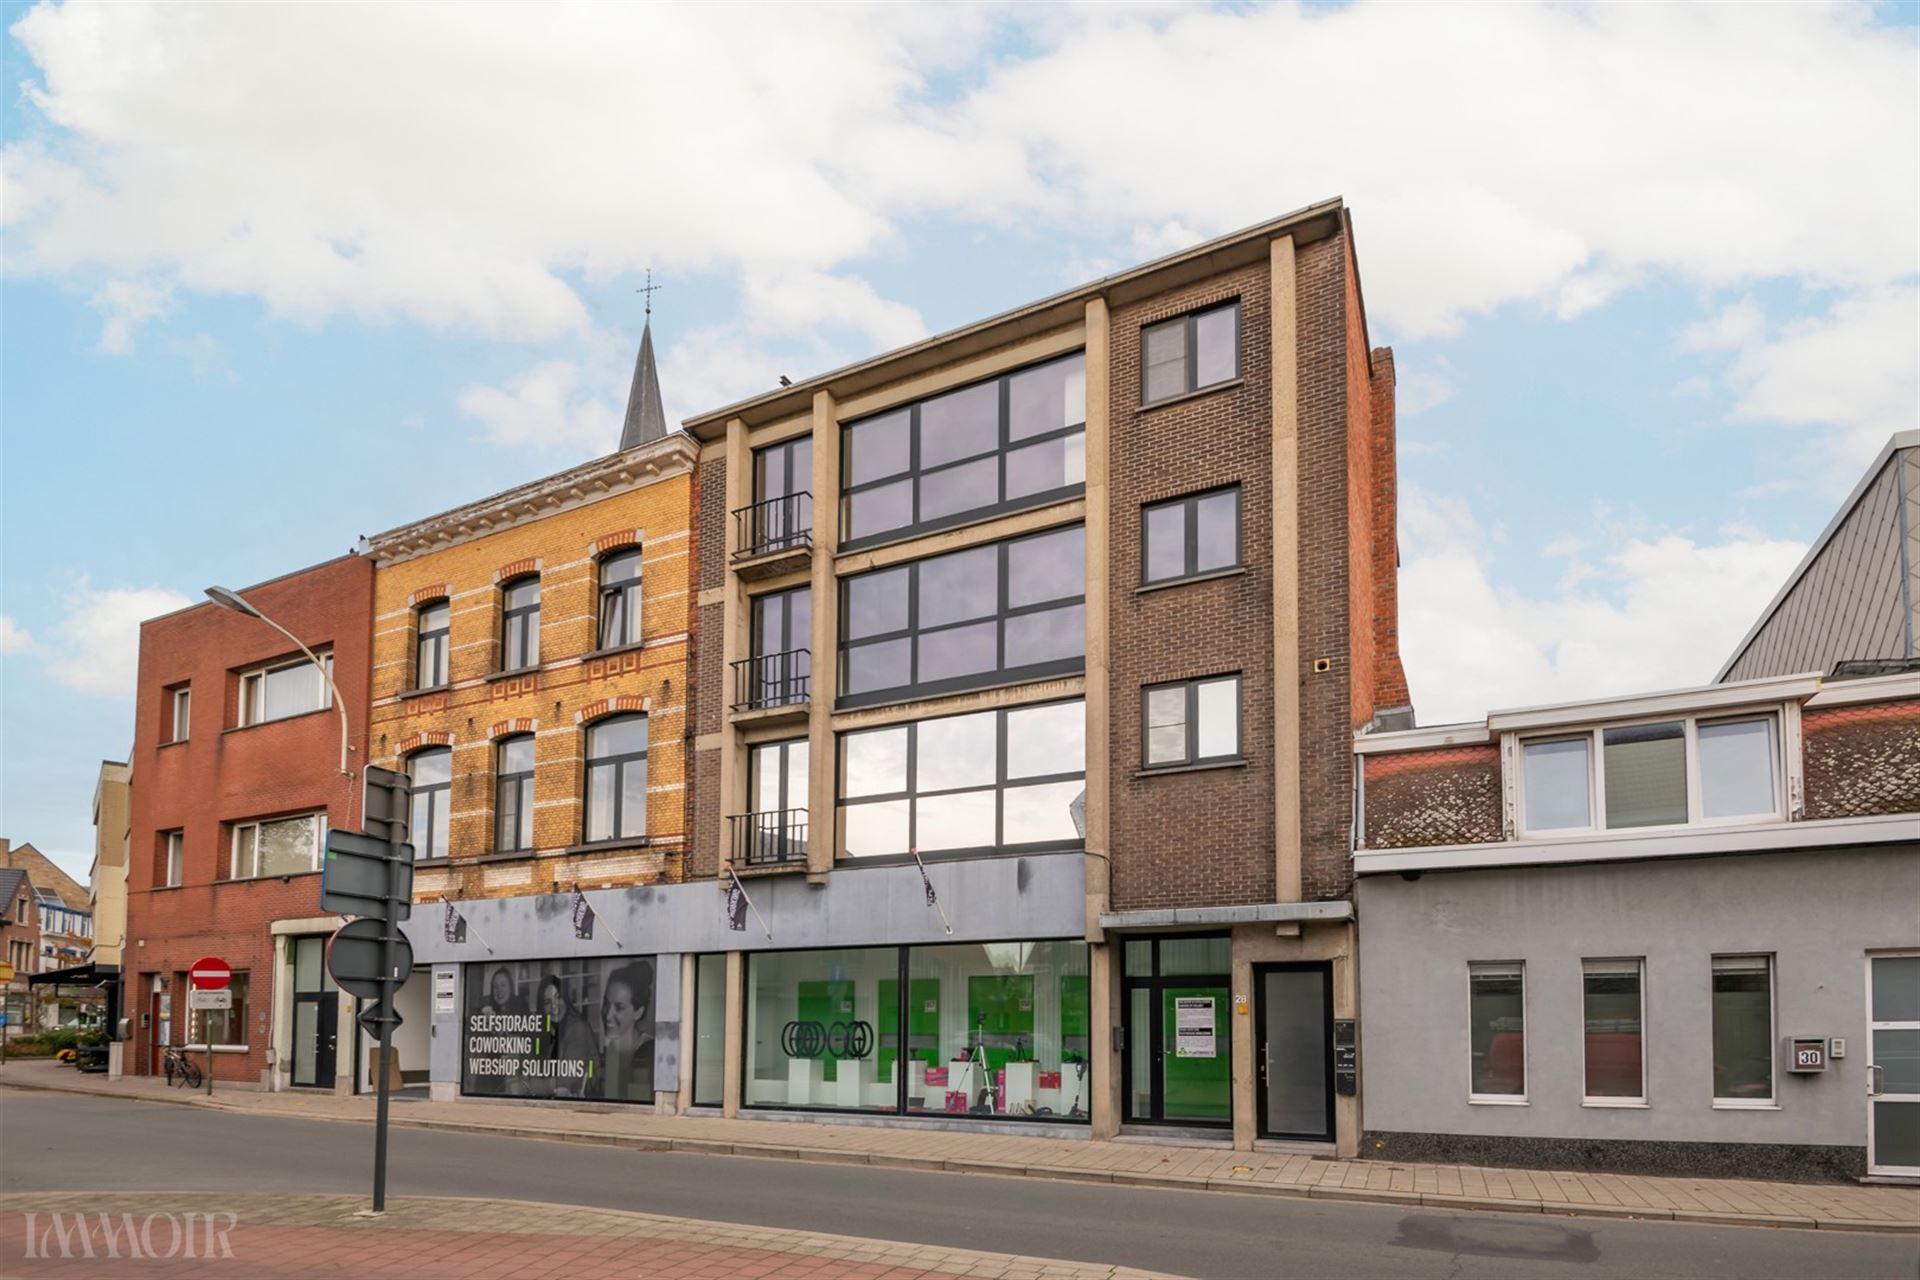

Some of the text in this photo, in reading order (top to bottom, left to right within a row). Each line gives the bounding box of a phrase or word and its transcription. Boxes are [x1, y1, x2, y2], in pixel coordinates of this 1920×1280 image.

[470, 1014, 543, 1032] SELFSTORAGE
[469, 1036, 532, 1054] COWORKING
[1801, 1051, 1818, 1064] 30
[469, 1058, 585, 1078] WEBSHOP SOLUTIONS
